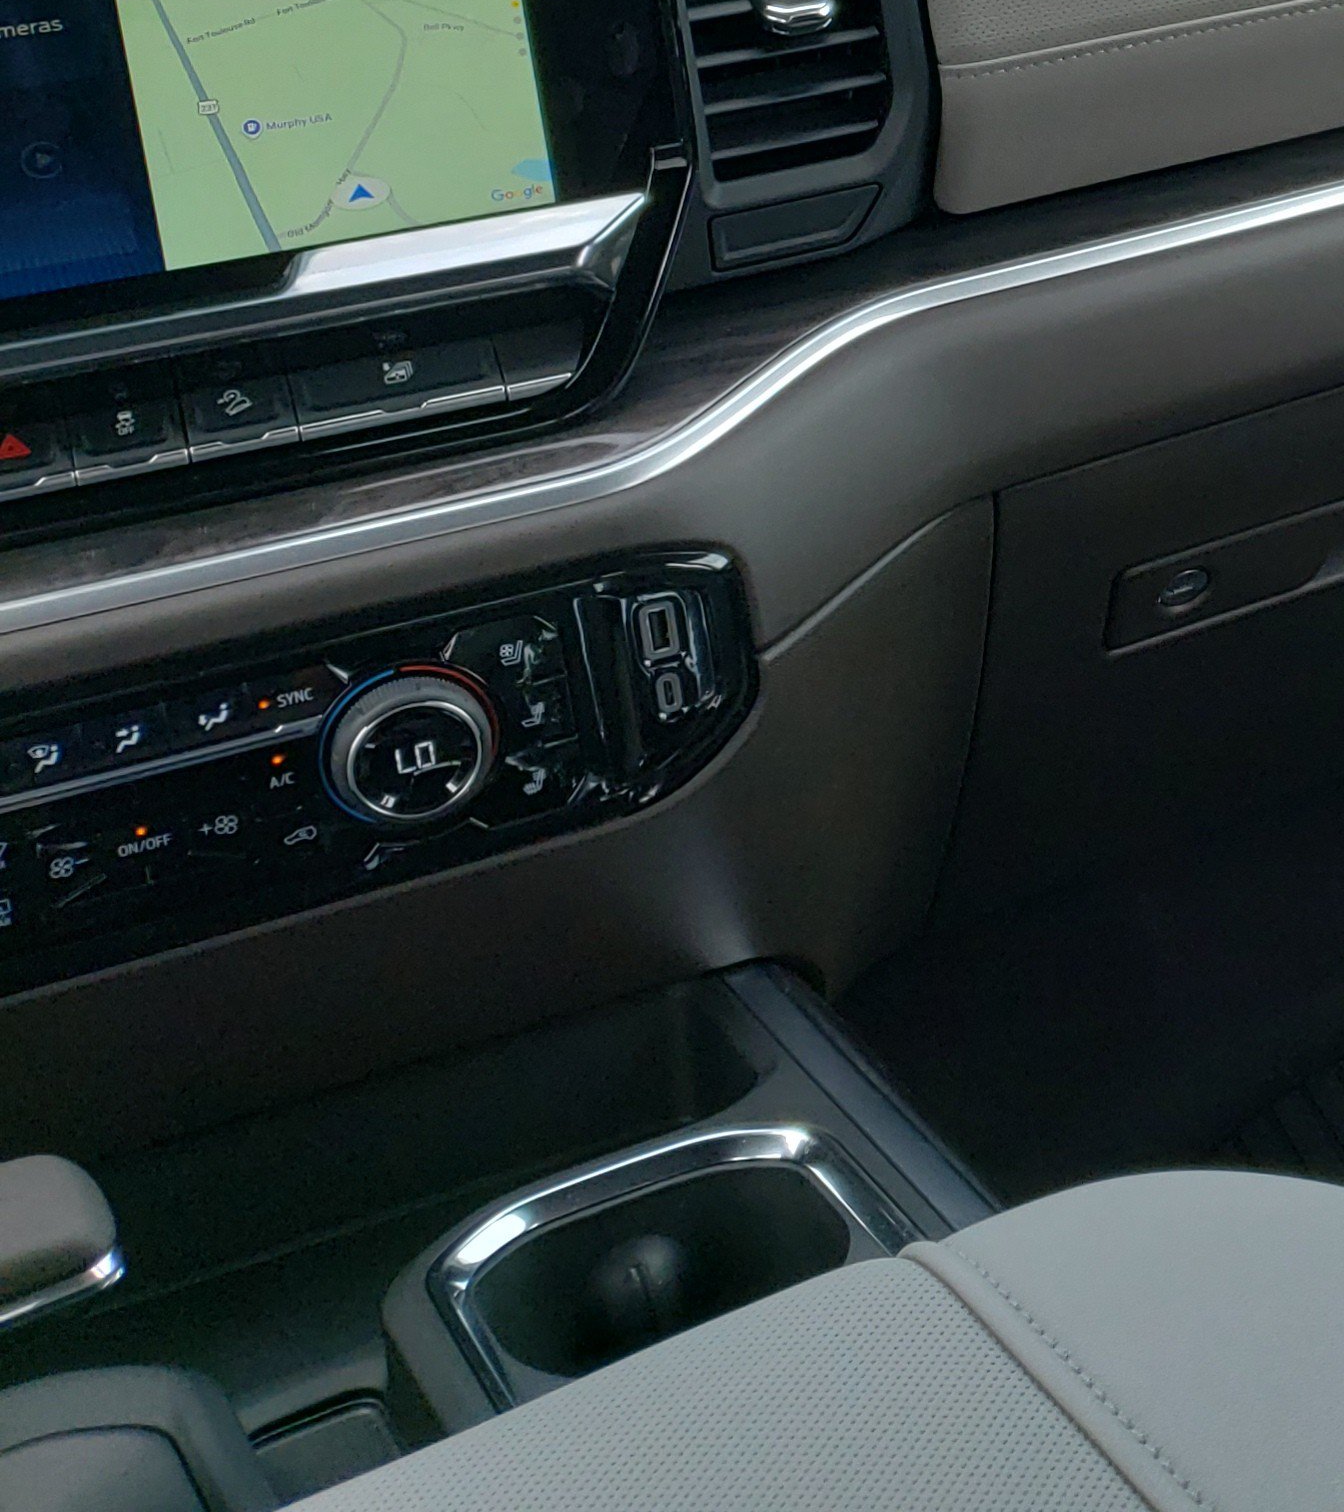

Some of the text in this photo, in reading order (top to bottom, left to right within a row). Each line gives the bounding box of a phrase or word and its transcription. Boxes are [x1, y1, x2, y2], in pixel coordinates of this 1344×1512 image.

[266, 113, 333, 131] Murphy USA
[491, 184, 543, 201] Google
[276, 687, 314, 708] SYNC
[394, 741, 436, 774] LO
[269, 771, 295, 789] A/C
[117, 832, 173, 858] ON/OFF
